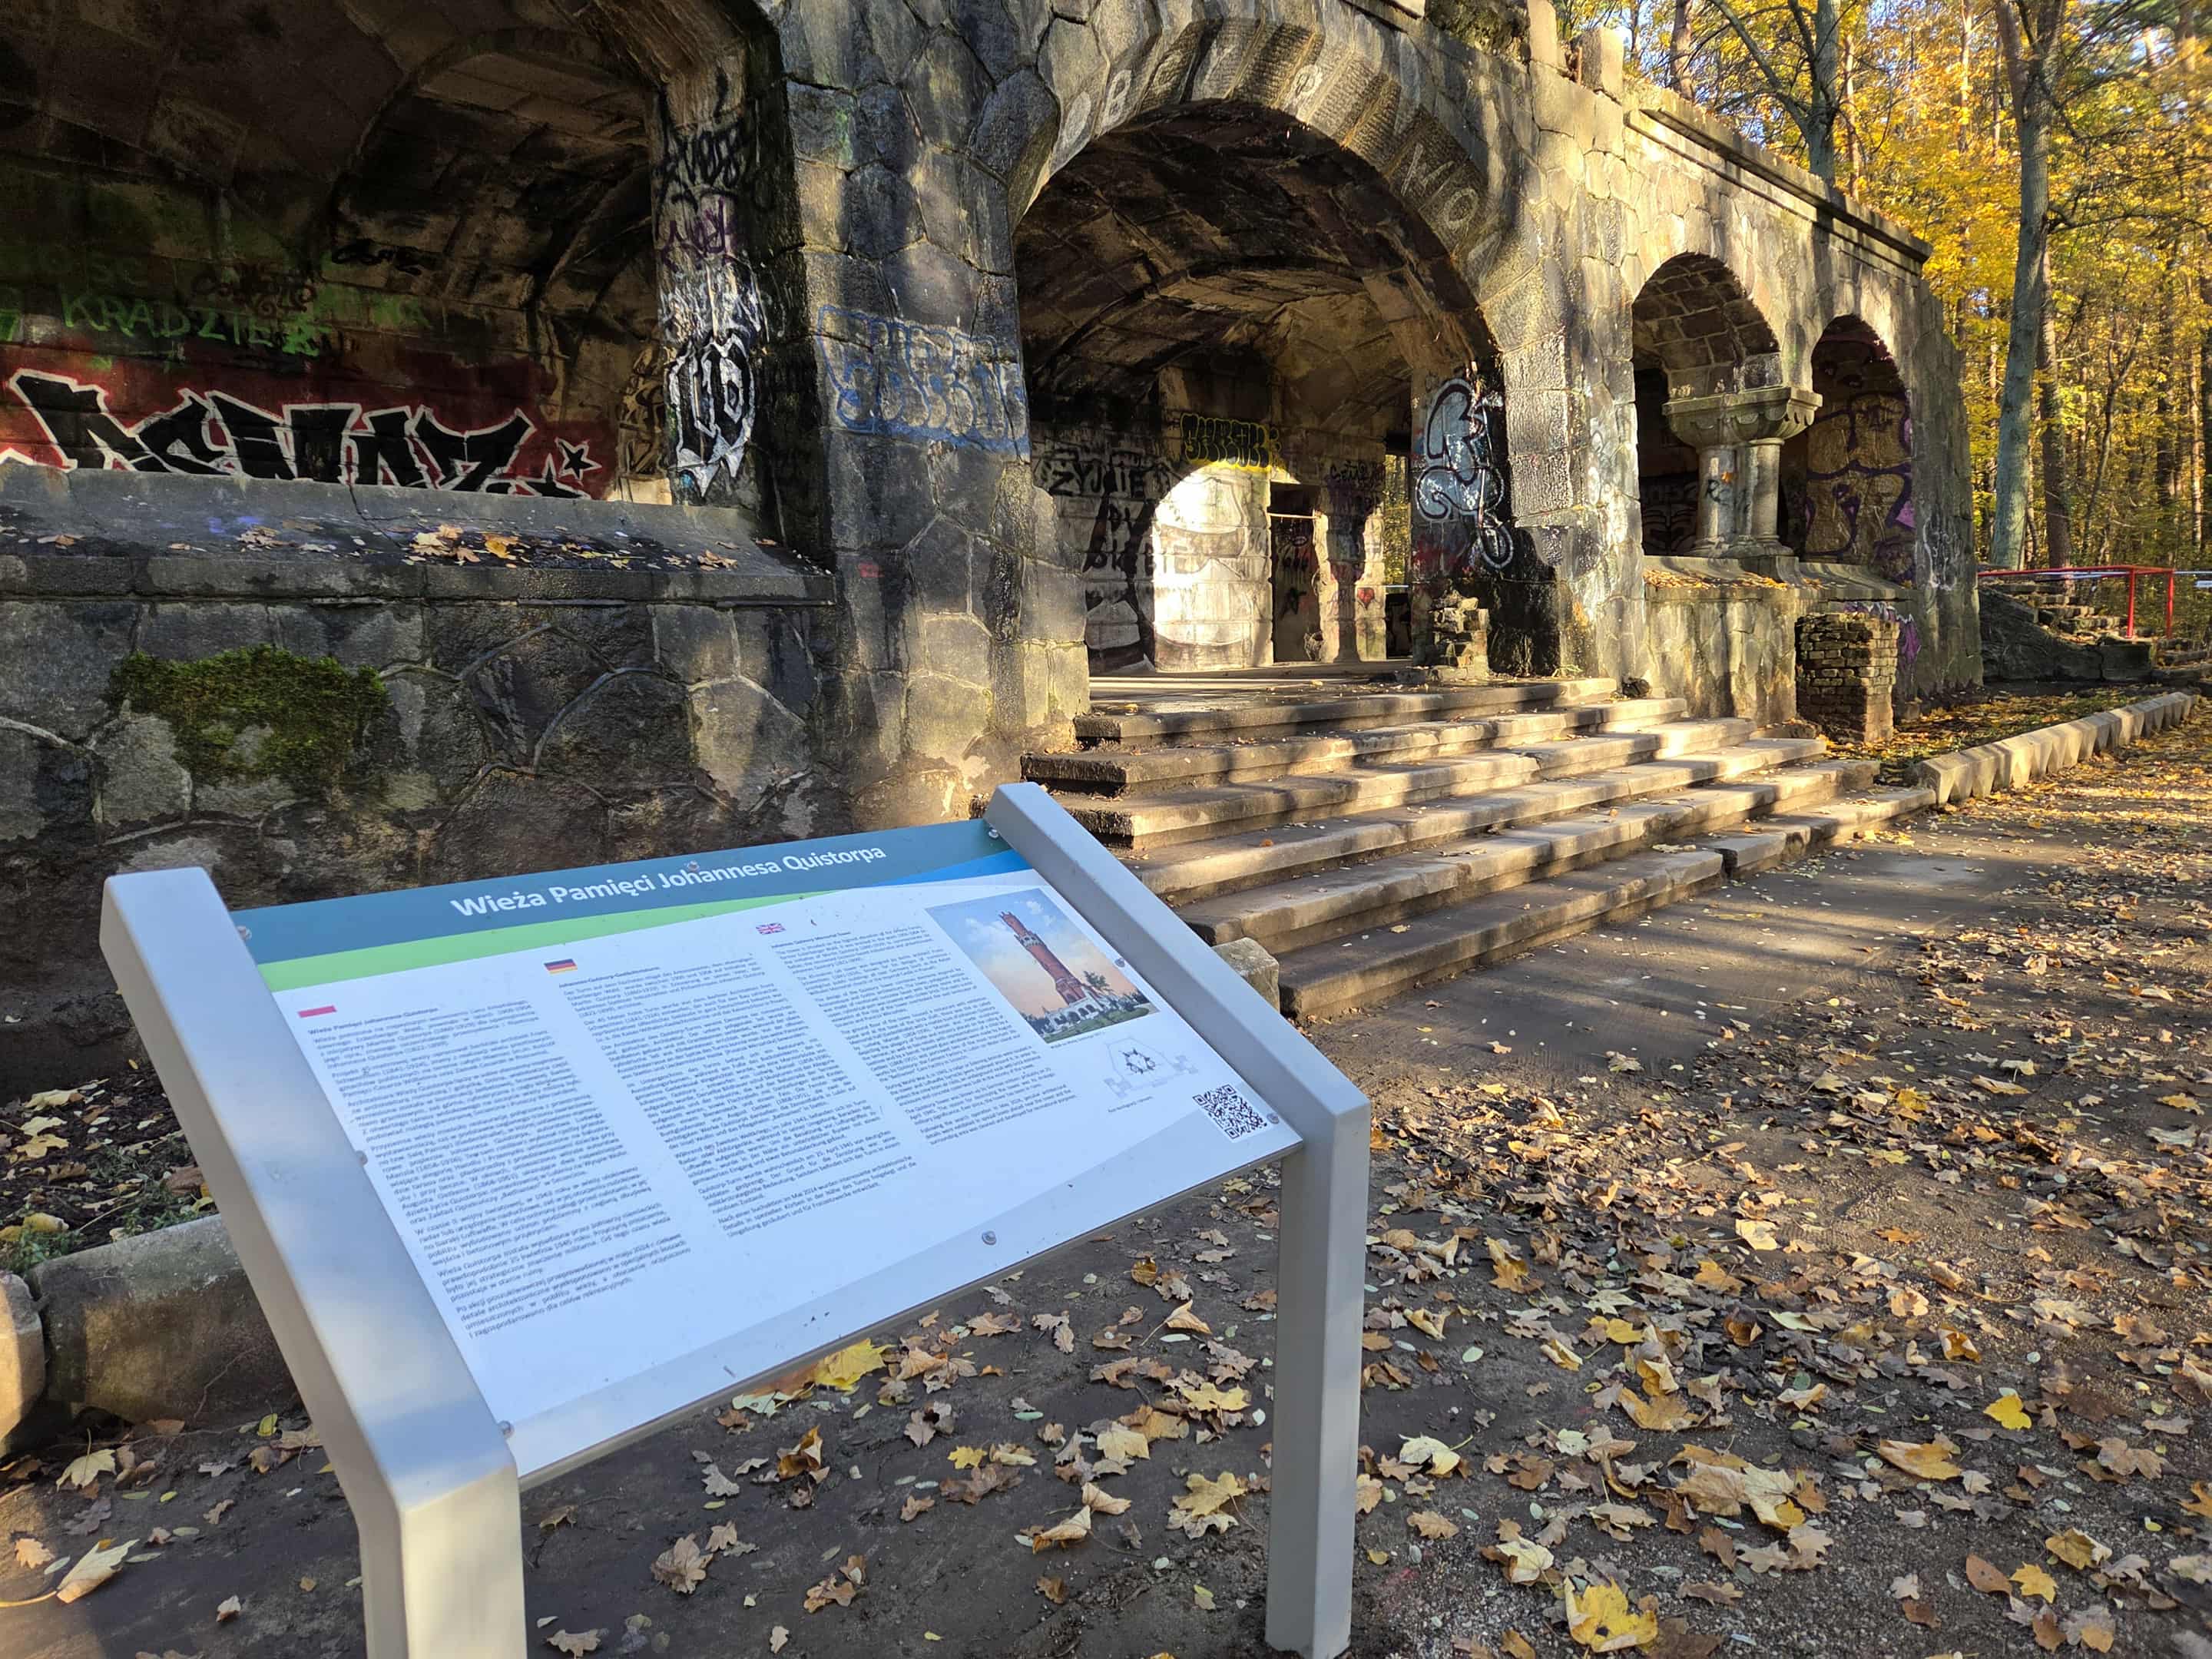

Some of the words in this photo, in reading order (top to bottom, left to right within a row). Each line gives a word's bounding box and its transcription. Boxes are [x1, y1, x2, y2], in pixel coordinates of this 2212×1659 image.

[451, 891, 547, 916] Wieża
[548, 875, 656, 903] Pamięci
[658, 862, 782, 888] Johannesa
[782, 847, 887, 872] Quistorpa
